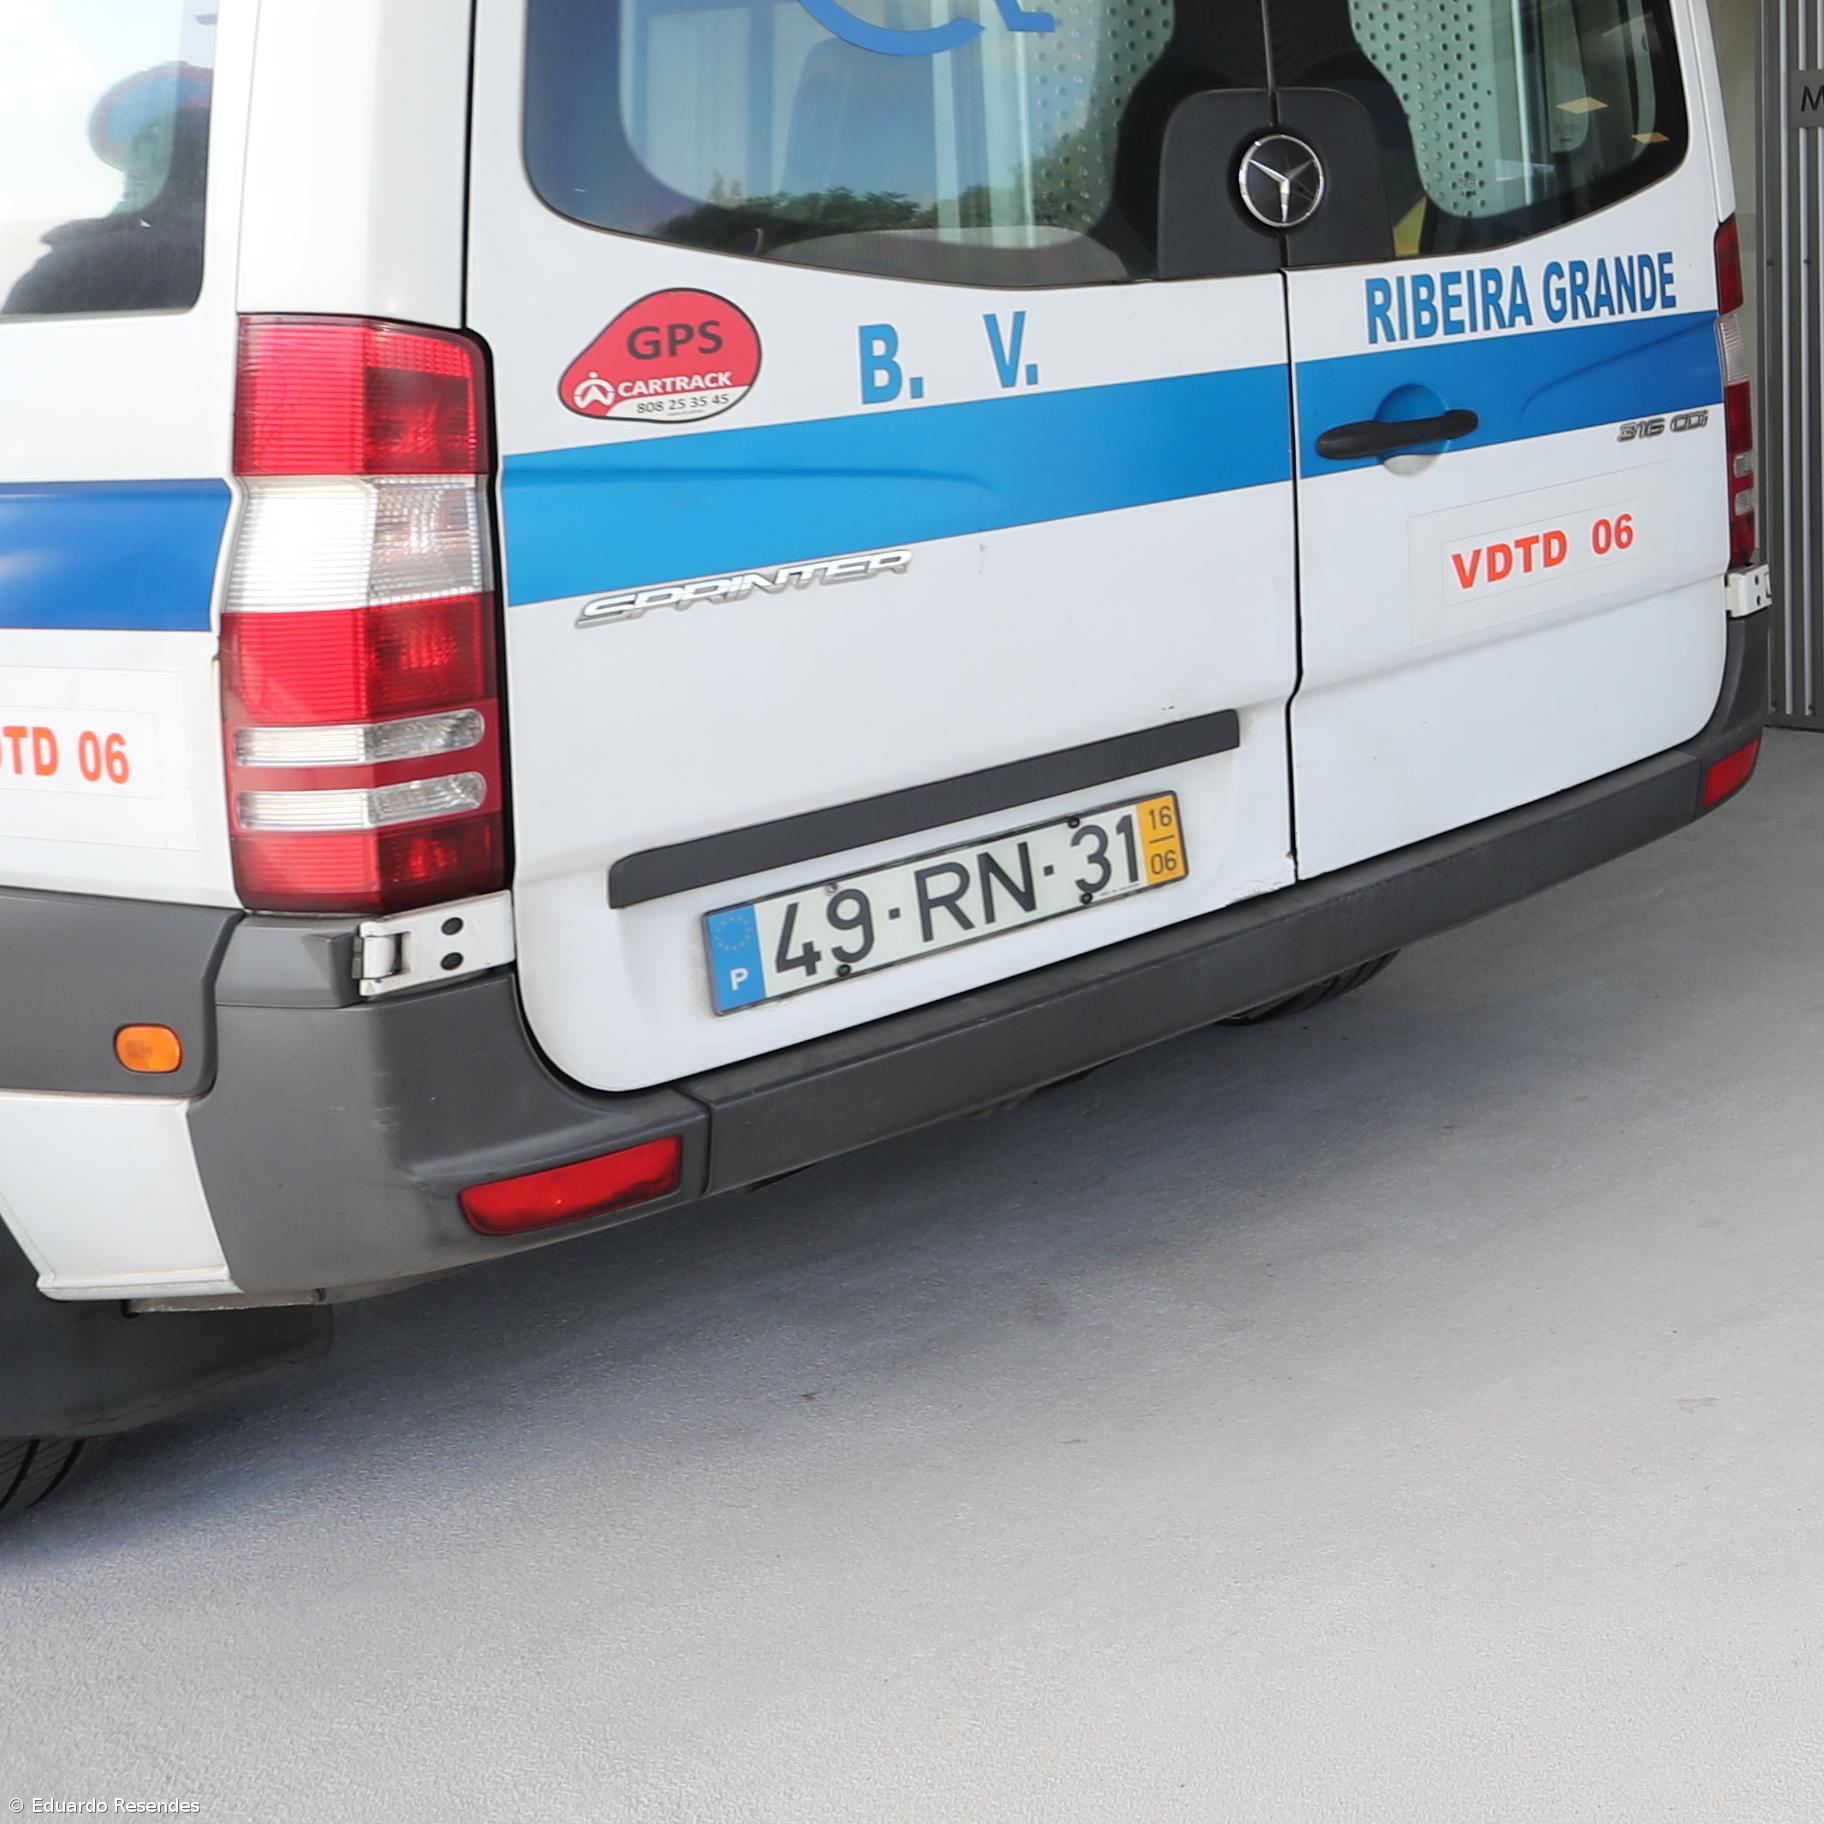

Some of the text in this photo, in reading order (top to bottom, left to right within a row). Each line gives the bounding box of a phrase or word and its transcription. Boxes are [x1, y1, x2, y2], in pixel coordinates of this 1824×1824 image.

[627, 320, 724, 360] GPS
[858, 251, 1677, 405] B. V. RIBEIRA GRANDE
[617, 371, 733, 397] CARTRACK
[636, 401, 664, 413] 808
[668, 398, 686, 410] 25
[690, 395, 708, 408] 35
[711, 393, 729, 404] 45
[1617, 417, 1666, 443] 316
[1451, 514, 1634, 590] VDTD 06
[574, 550, 913, 629] SPRINTER
[0, 725, 130, 784] TD 06
[1149, 805, 1173, 830] 16
[1151, 849, 1178, 875] 06
[729, 968, 749, 991] P
